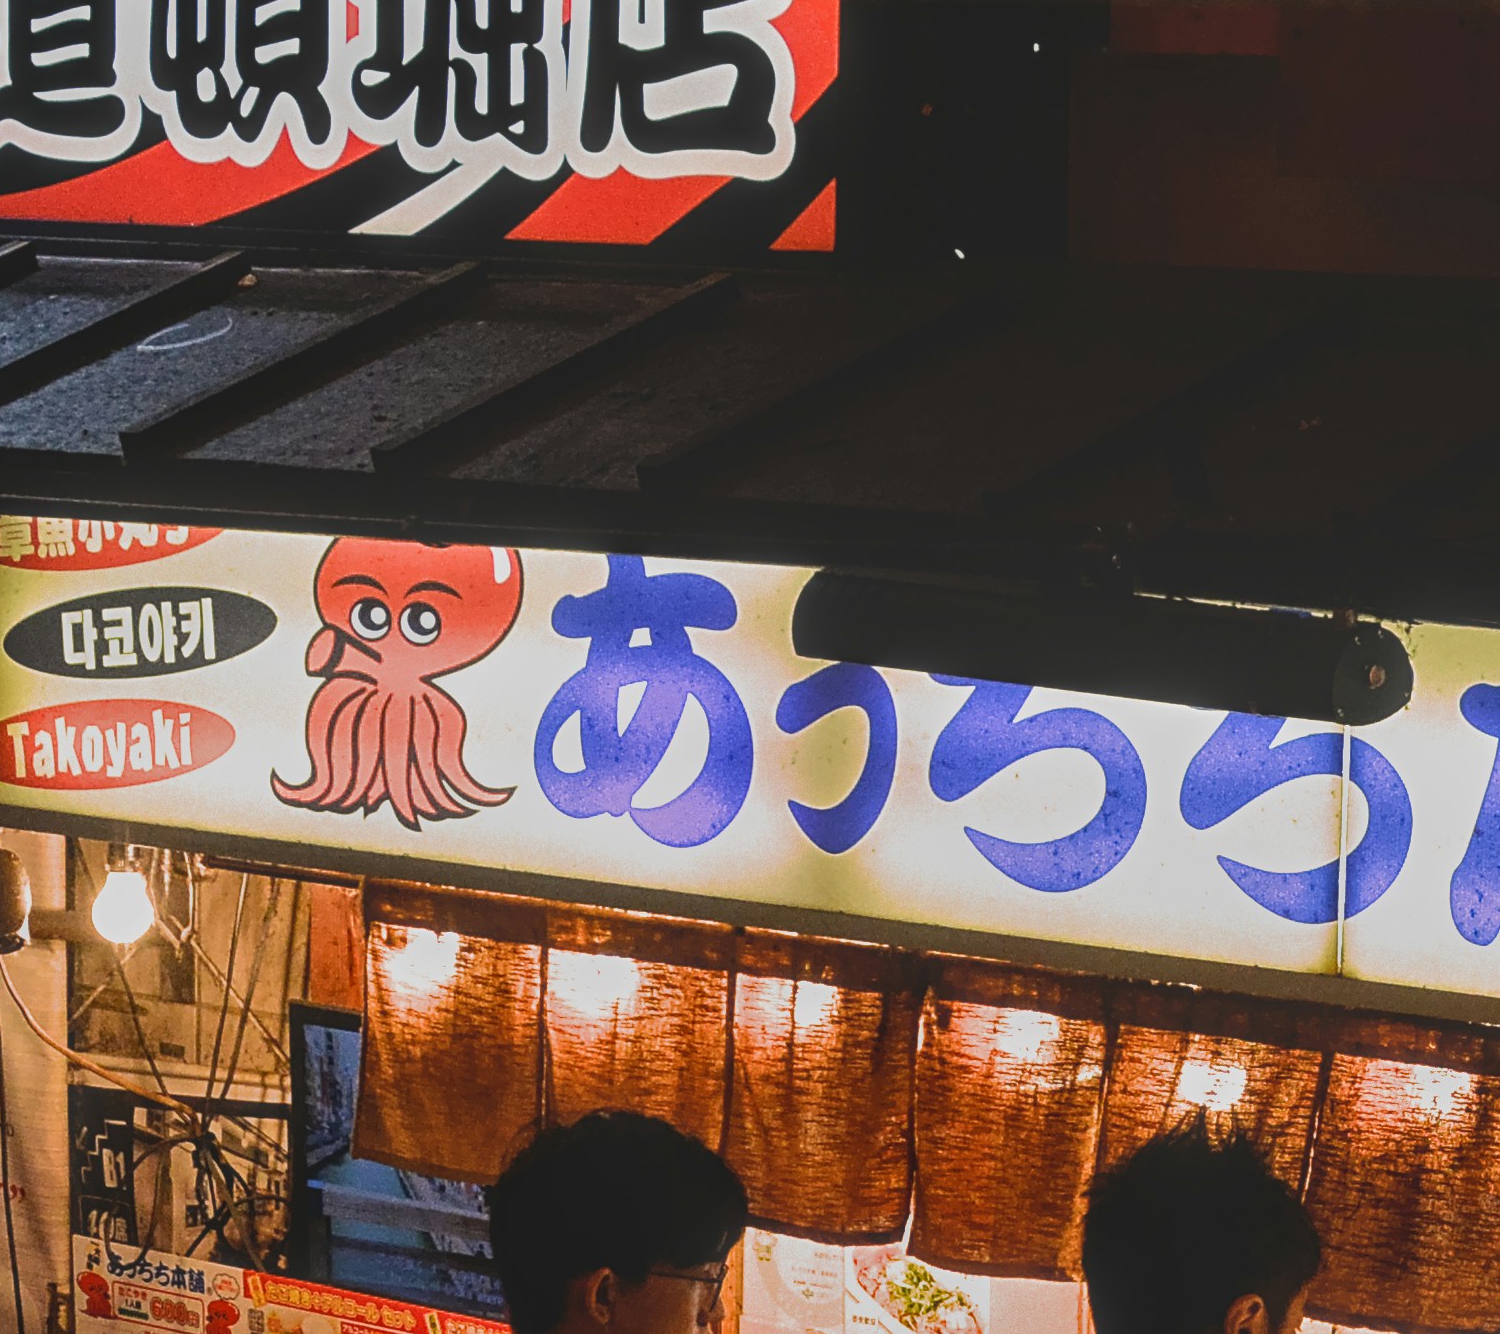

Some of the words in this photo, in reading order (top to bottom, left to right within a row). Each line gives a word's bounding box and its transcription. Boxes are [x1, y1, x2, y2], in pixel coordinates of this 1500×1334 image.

[60, 597, 216, 670] 다코야키
[6, 709, 193, 779] Takoyaki
[150, 1295, 201, 1329] 600円
